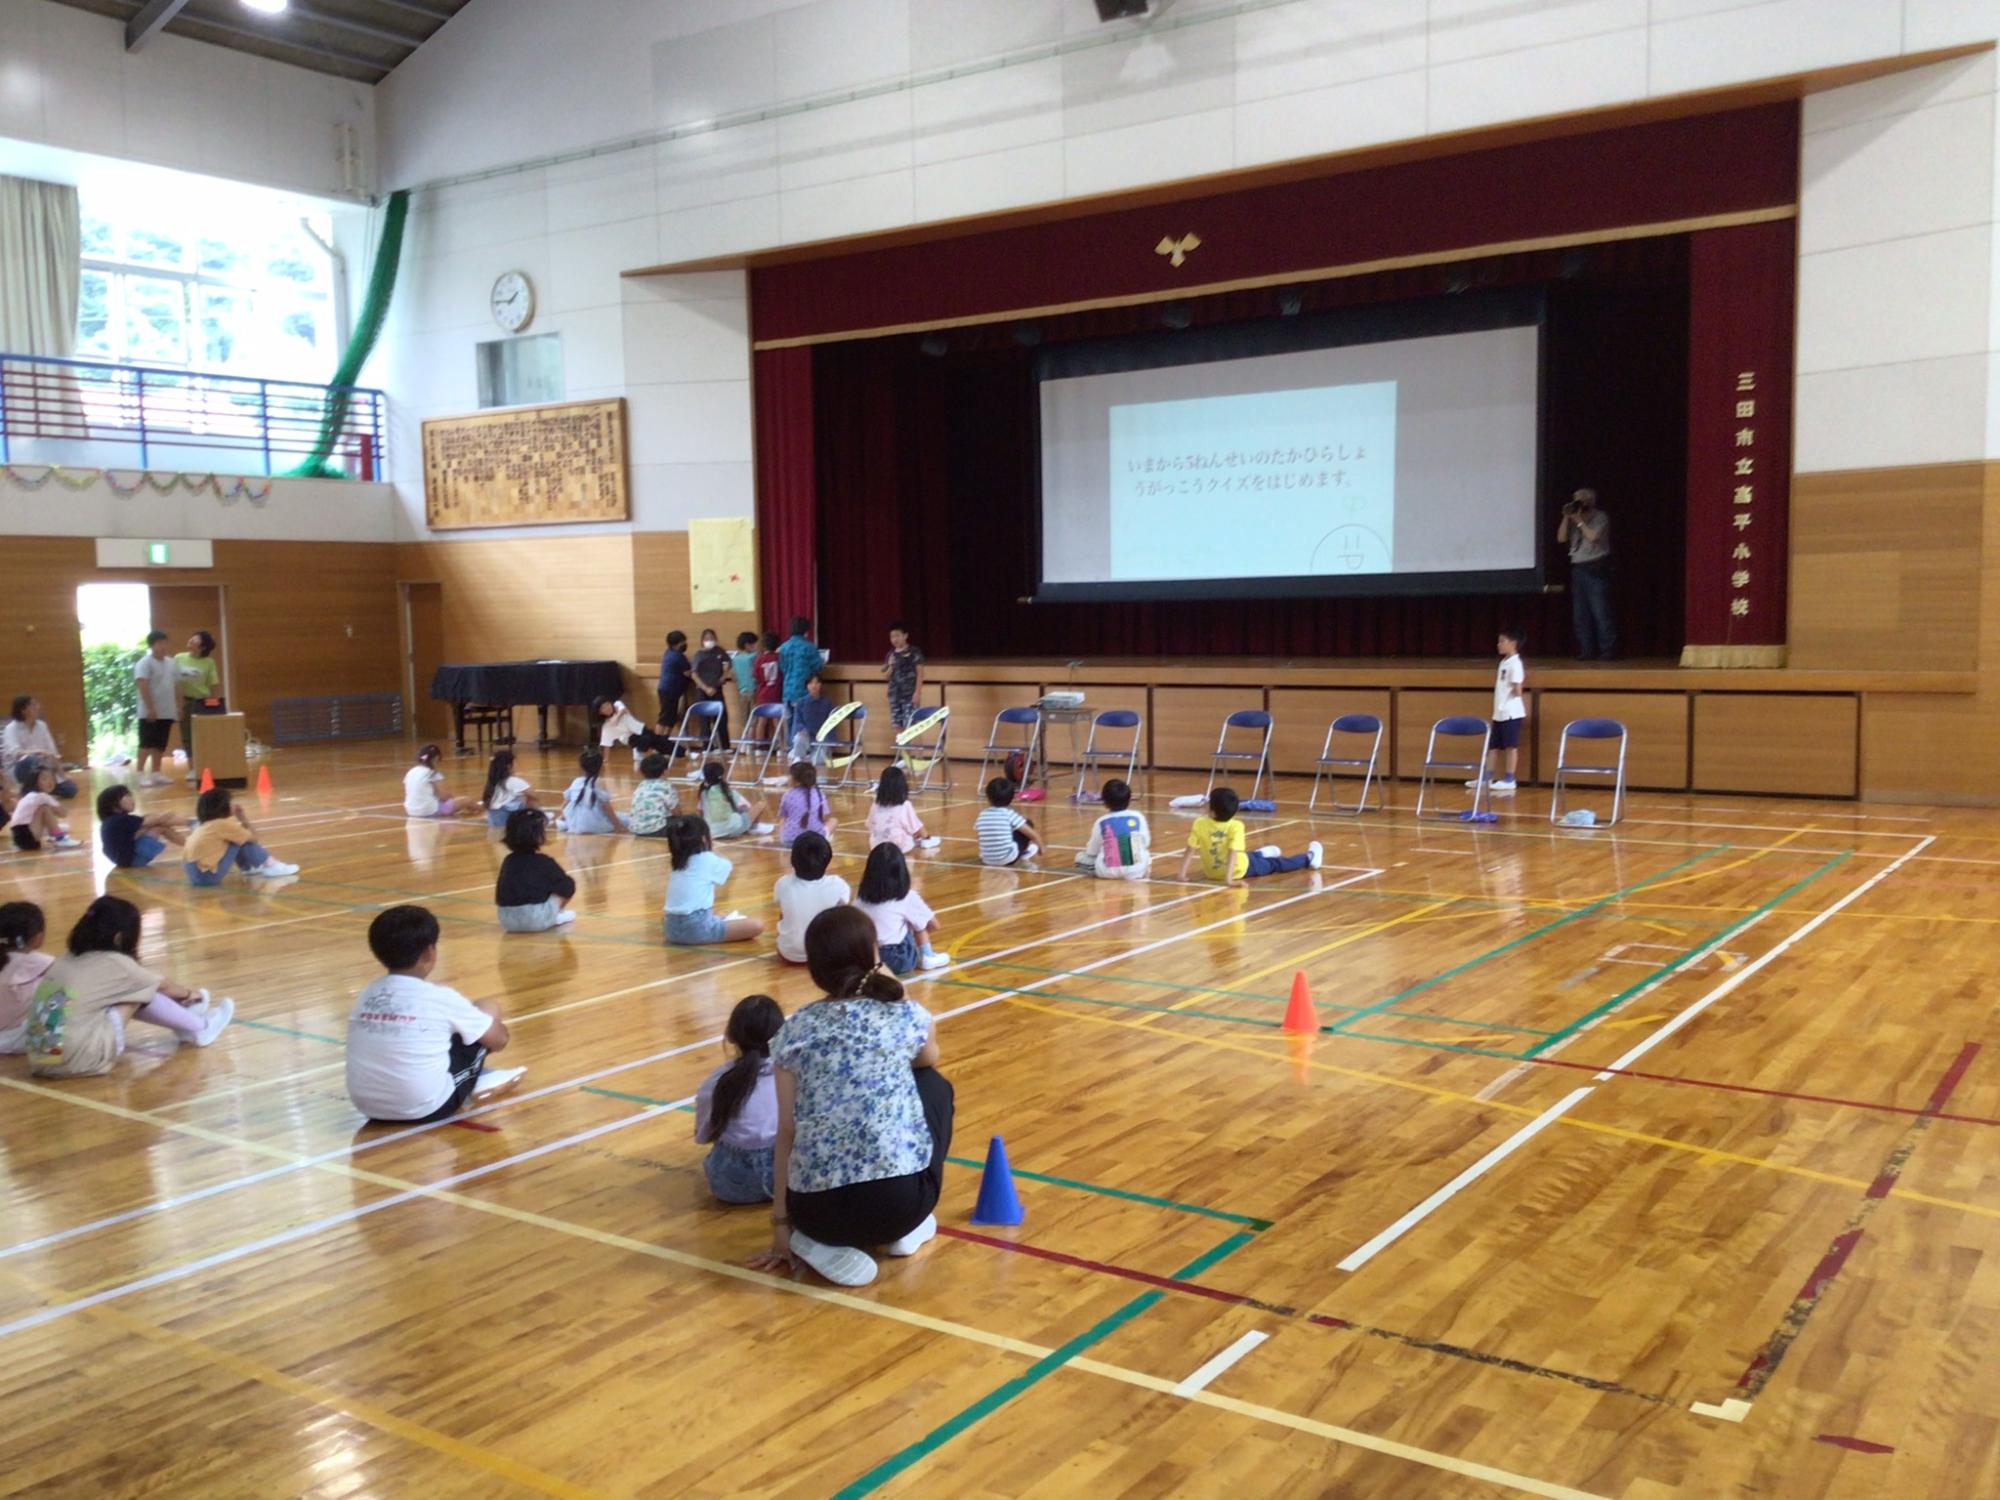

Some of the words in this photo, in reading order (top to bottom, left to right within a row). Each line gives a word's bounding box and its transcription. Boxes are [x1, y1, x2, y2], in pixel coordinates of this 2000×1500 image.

[1730, 371, 1756, 615] 三田市立高平小学校
